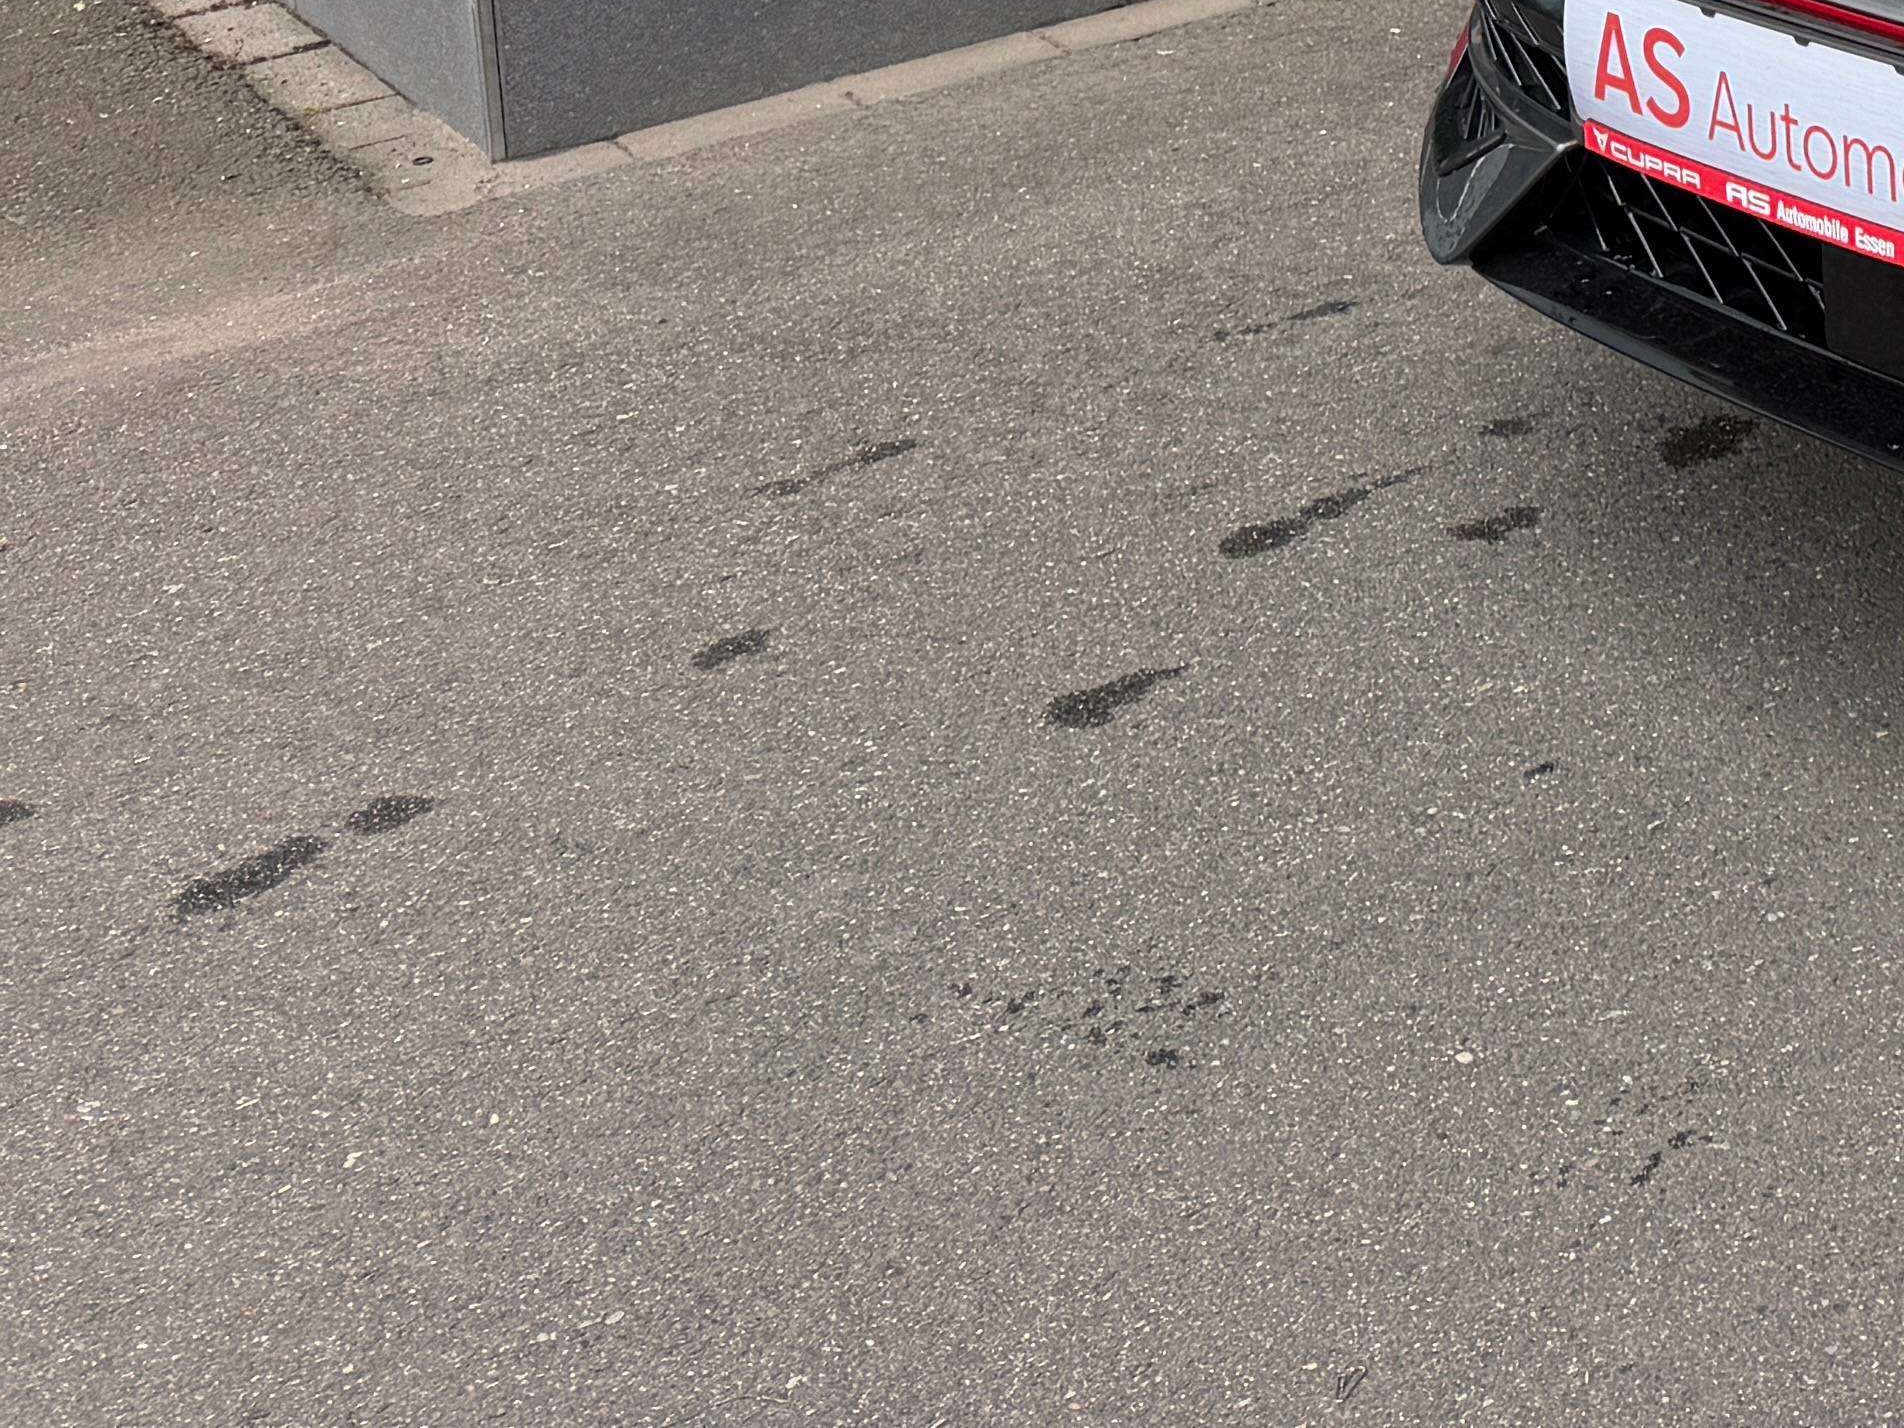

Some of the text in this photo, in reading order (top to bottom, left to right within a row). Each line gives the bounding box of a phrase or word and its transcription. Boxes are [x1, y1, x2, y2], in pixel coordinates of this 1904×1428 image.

[1594, 11, 1691, 129] AS
[1610, 140, 1702, 191] CUPRA
[1725, 180, 1771, 216] AS
[1776, 200, 1849, 244] Automobile
[1854, 227, 1896, 259] Essen
